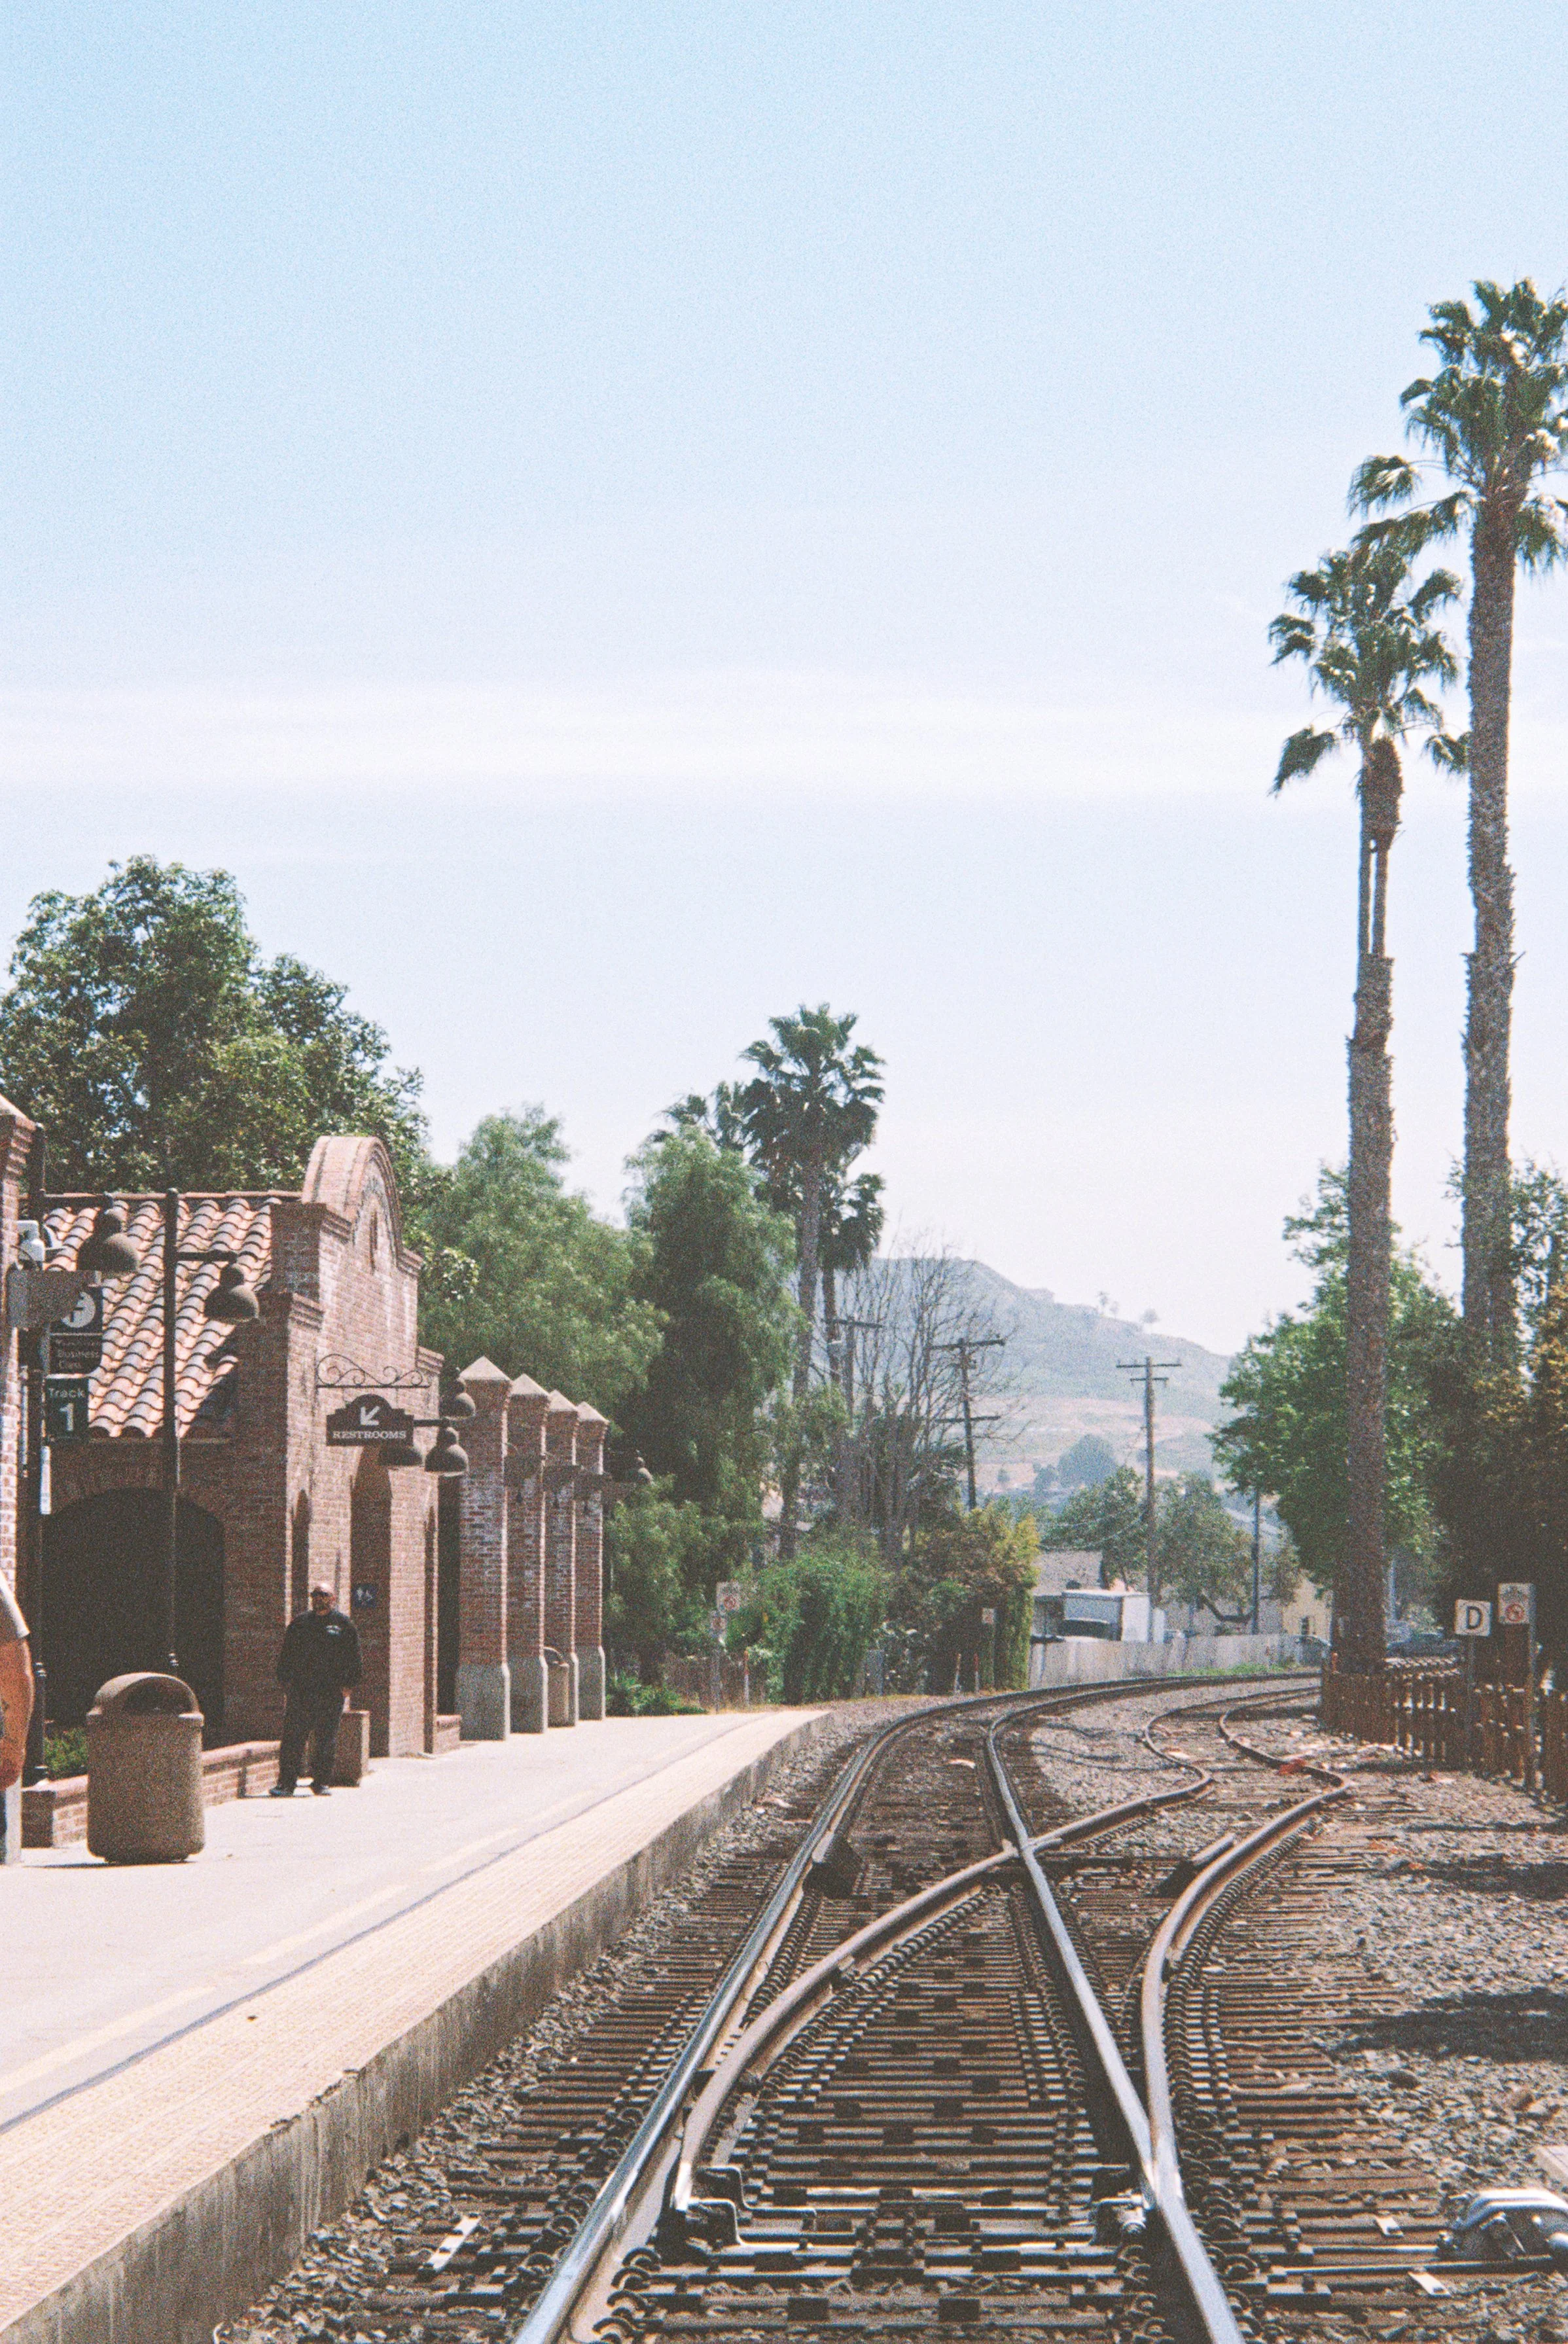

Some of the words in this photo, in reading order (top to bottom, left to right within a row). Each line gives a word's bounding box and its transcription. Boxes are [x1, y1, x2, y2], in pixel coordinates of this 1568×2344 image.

[48, 1387, 86, 1398] Track
[60, 1403, 73, 1432] 1
[332, 1430, 406, 1439] RESTROOMS
[1466, 1605, 1483, 1630] D
